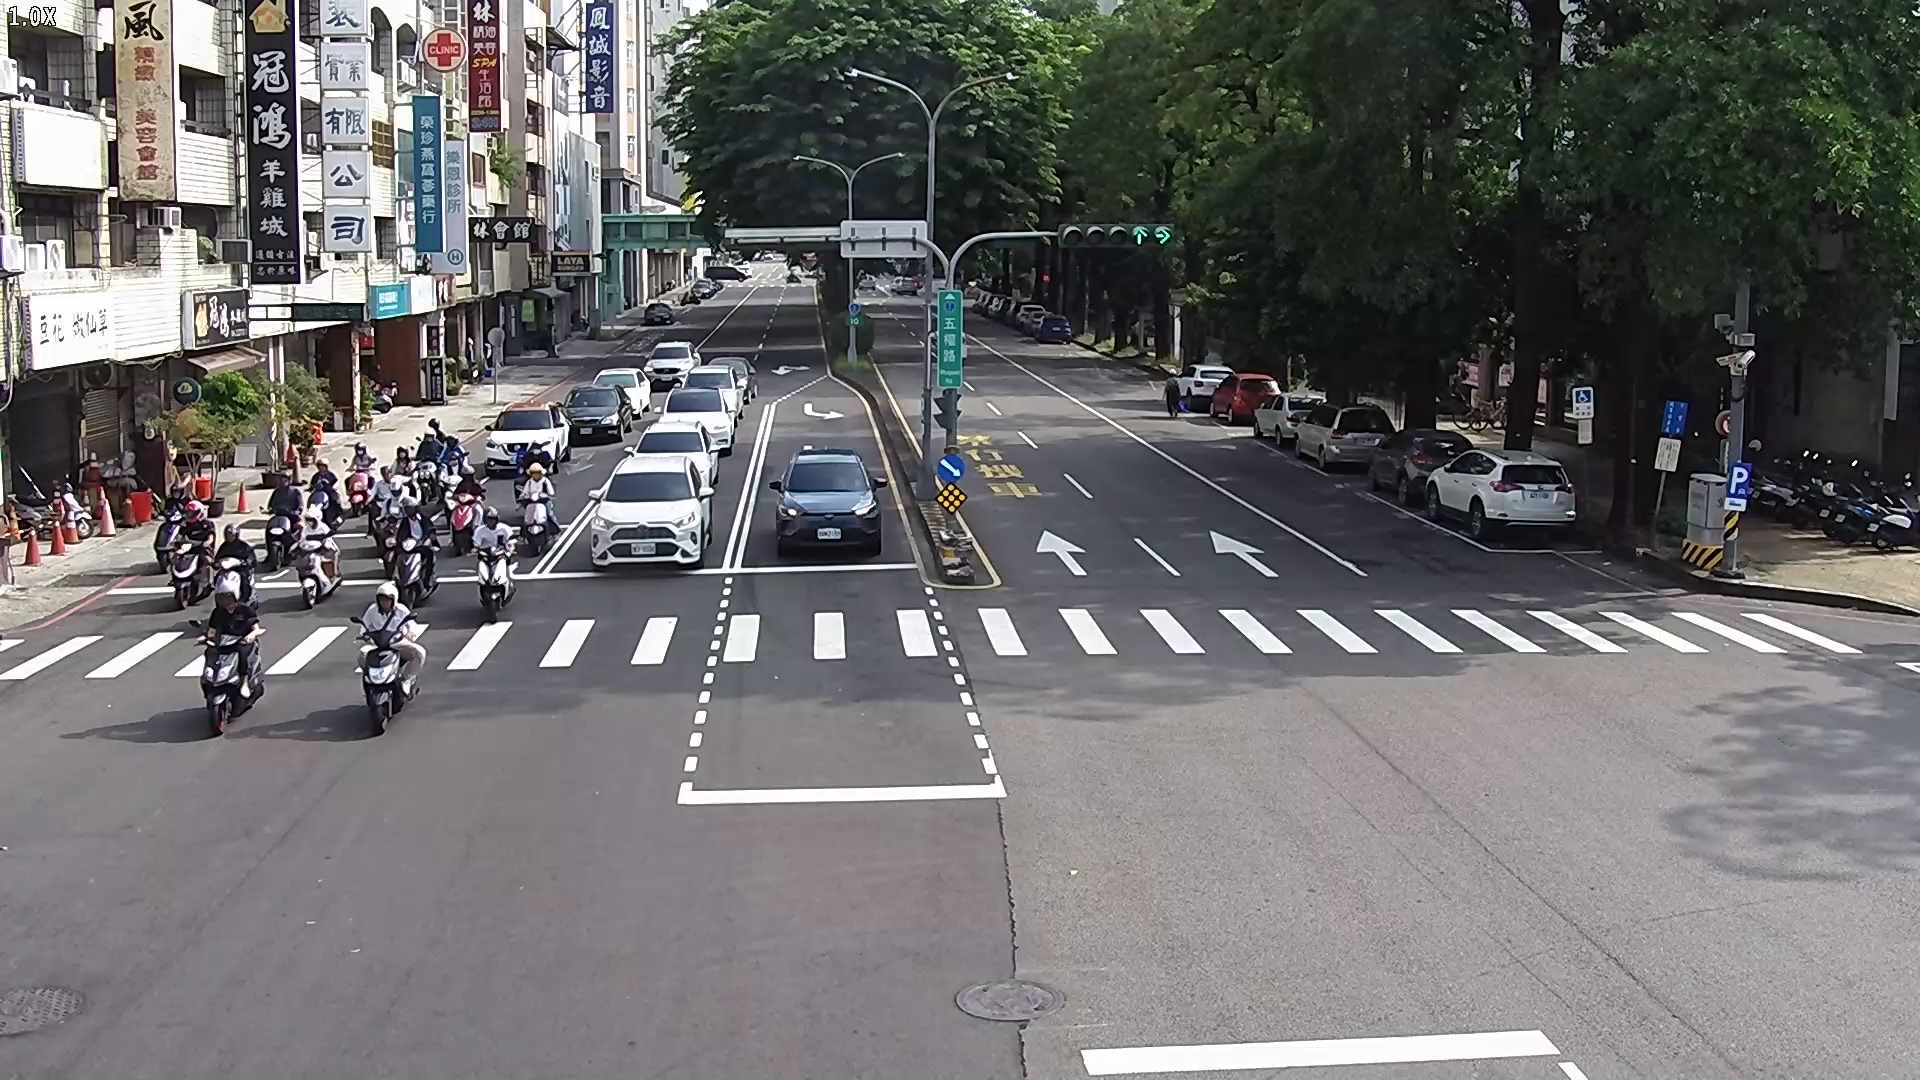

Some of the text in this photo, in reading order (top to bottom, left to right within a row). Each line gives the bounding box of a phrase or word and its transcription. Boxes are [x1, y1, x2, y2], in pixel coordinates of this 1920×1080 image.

[124, 1, 164, 41] 風
[473, 0, 495, 23] 林
[429, 46, 460, 56] CLINIC
[472, 58, 497, 68] SPA
[325, 107, 366, 136] 有限
[473, 220, 531, 240] 林會館
[557, 256, 584, 265] LAYA
[1730, 466, 1748, 494] P
